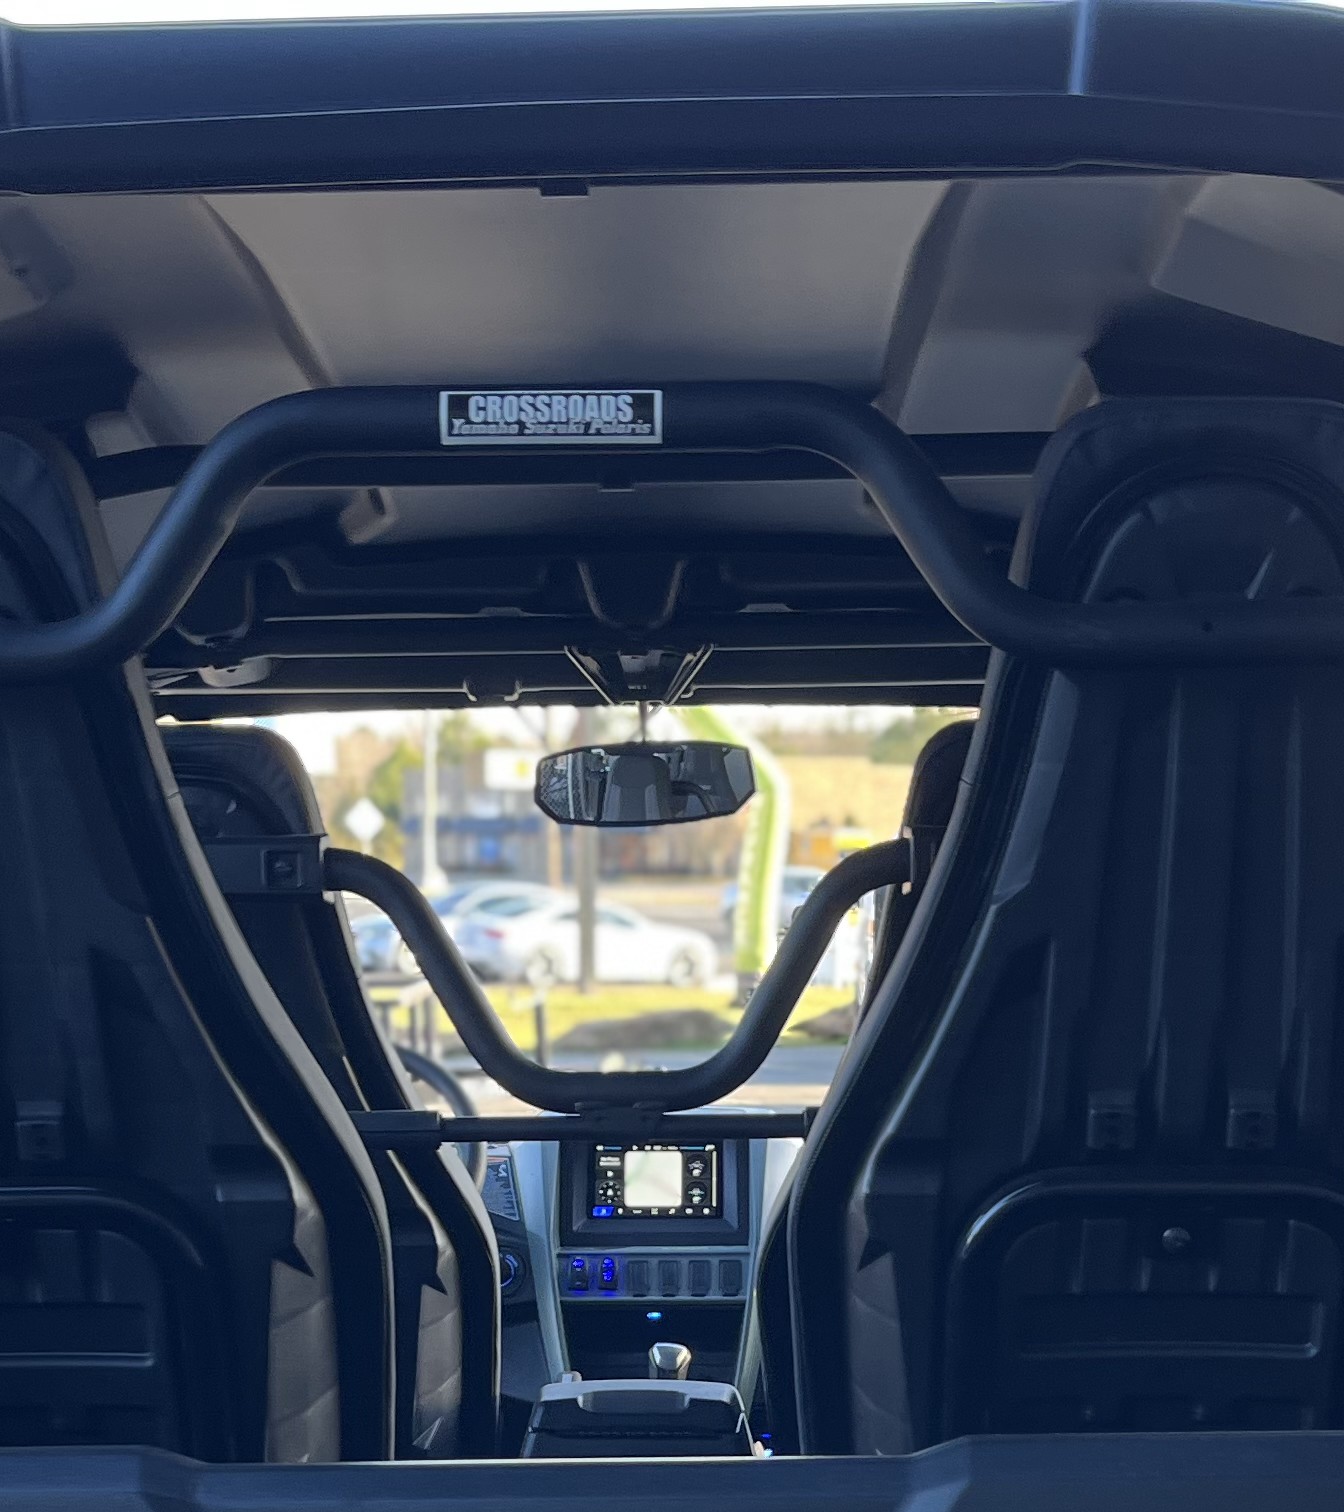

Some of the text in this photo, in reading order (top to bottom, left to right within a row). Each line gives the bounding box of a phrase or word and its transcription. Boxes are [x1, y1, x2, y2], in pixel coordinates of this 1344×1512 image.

[468, 395, 633, 422] CROSSROADS
[451, 418, 652, 435] Yamaha Suzuki Polaris
